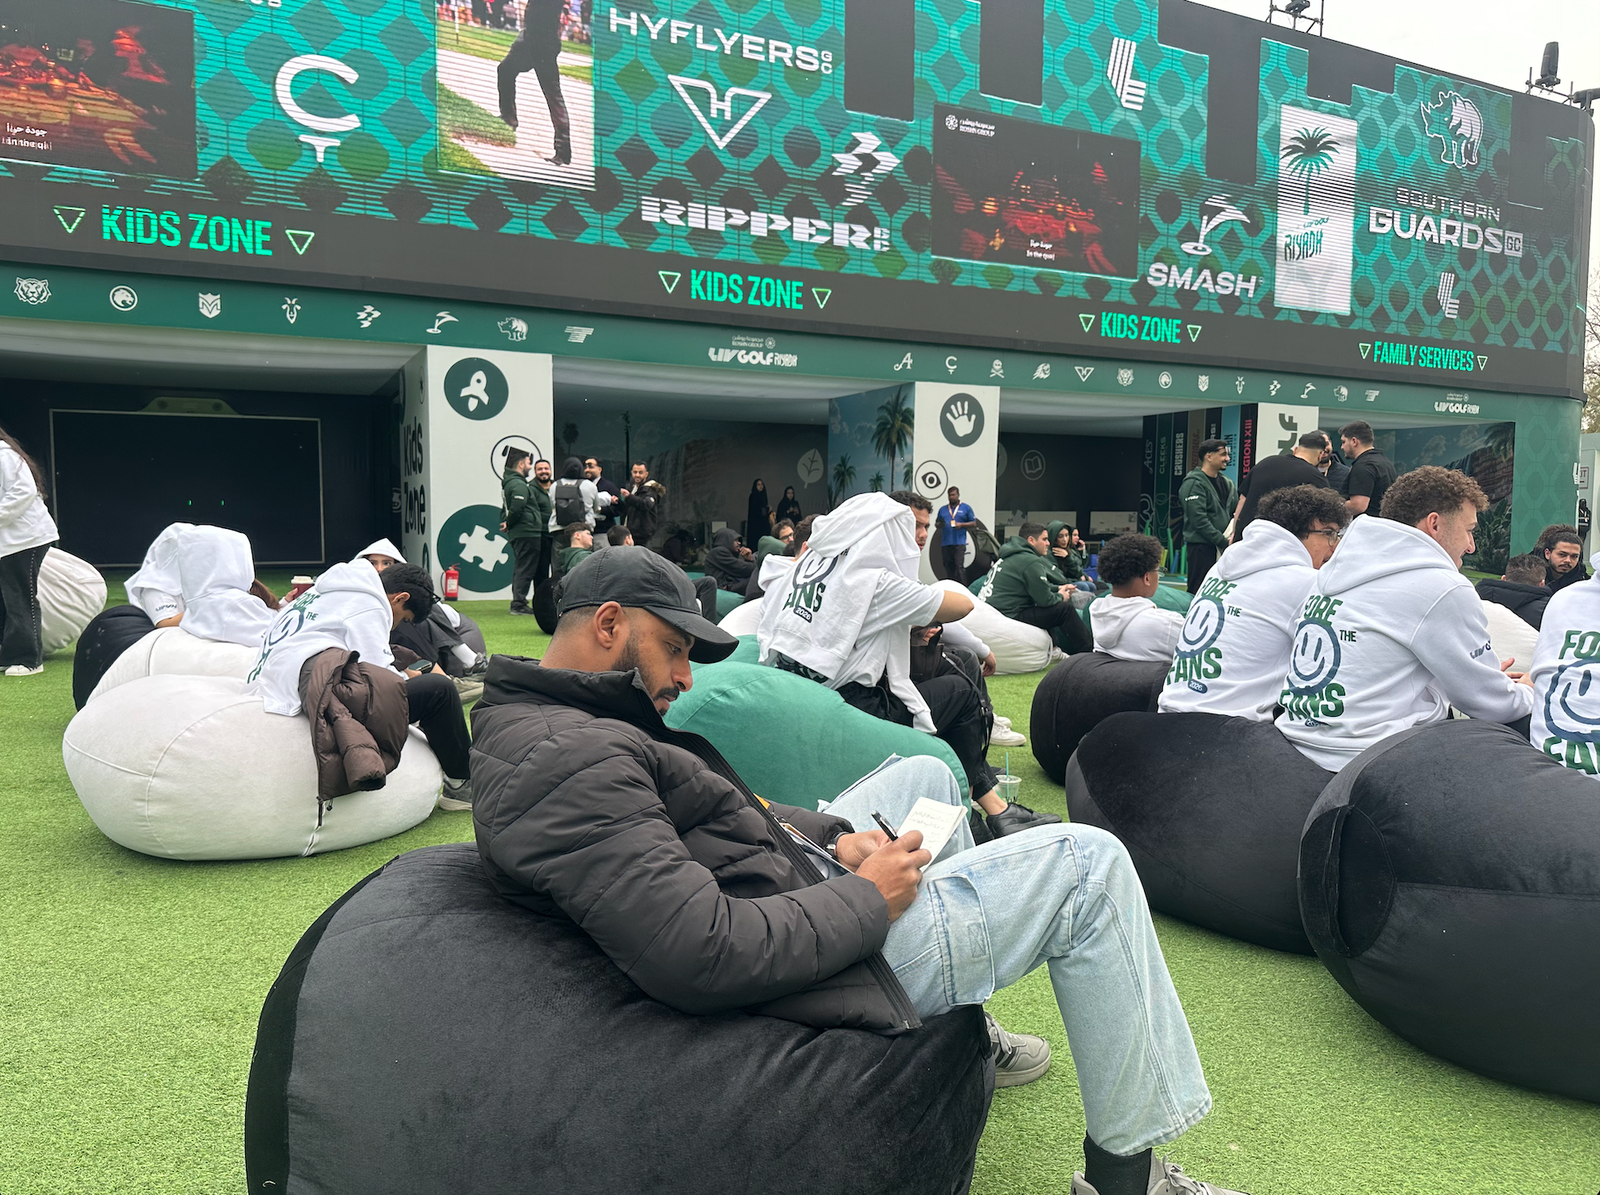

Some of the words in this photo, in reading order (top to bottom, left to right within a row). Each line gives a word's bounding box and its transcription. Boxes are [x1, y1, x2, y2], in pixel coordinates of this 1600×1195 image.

[609, 7, 819, 72] HYFLYERS
[1396, 187, 1501, 222] SOUTHERN
[102, 204, 182, 247] KIDS
[188, 213, 273, 256] ZONE
[641, 196, 872, 250] RIPPER
[1368, 206, 1504, 254] GUARDS
[1505, 234, 1522, 254] GC
[691, 269, 743, 303] KIDS
[748, 276, 804, 309] ZONE
[1147, 262, 1257, 298] SMASH
[1100, 312, 1138, 339] KIDS
[1141, 316, 1182, 343] ZONE
[737, 350, 774, 366] GOLF
[1373, 341, 1417, 366] FAMILY
[1419, 348, 1474, 371] SERVICES
[1244, 419, 1253, 437] XIII
[403, 416, 423, 477] Kids
[1174, 432, 1184, 476] CRUSHERS
[404, 481, 426, 535] Zone
[782, 581, 826, 613] ANS
[795, 606, 812, 621] 2026
[1227, 605, 1242, 617] THE
[306, 611, 319, 621] THE
[1339, 629, 1357, 642] THE
[1558, 629, 1600, 661] FO
[1543, 734, 1600, 775] FA
